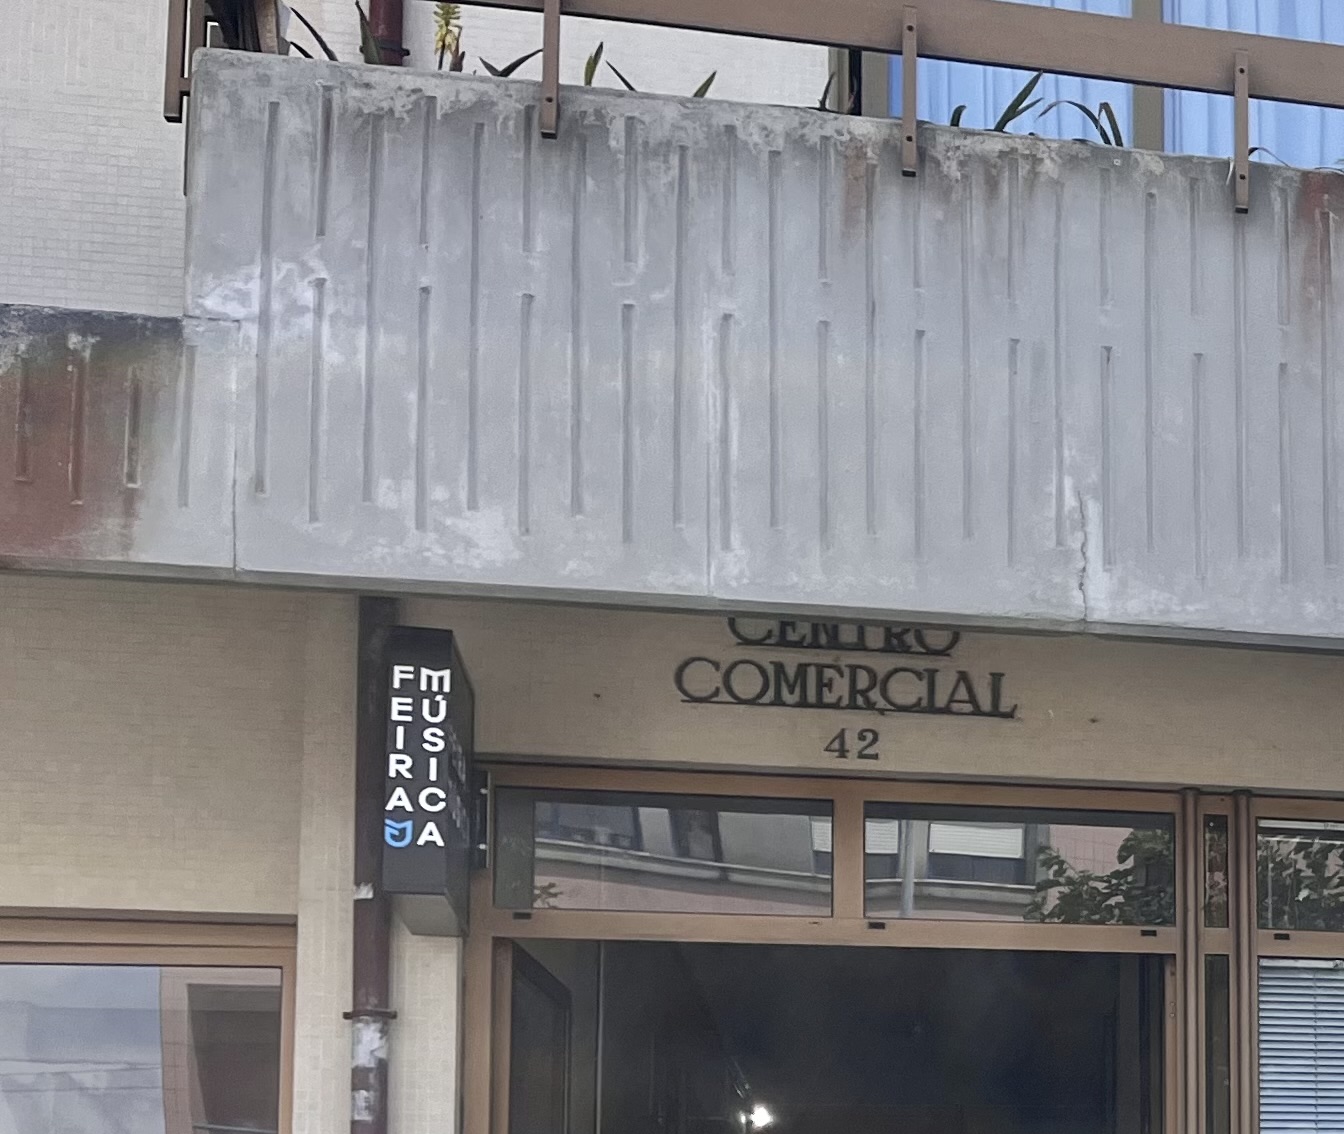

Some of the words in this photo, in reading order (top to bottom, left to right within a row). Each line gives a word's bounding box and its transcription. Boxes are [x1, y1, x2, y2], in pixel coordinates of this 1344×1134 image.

[385, 664, 415, 812] FEIRA
[674, 656, 1018, 718] COMERCIAL
[416, 666, 451, 847] MÚSICA
[823, 728, 879, 760] 42
